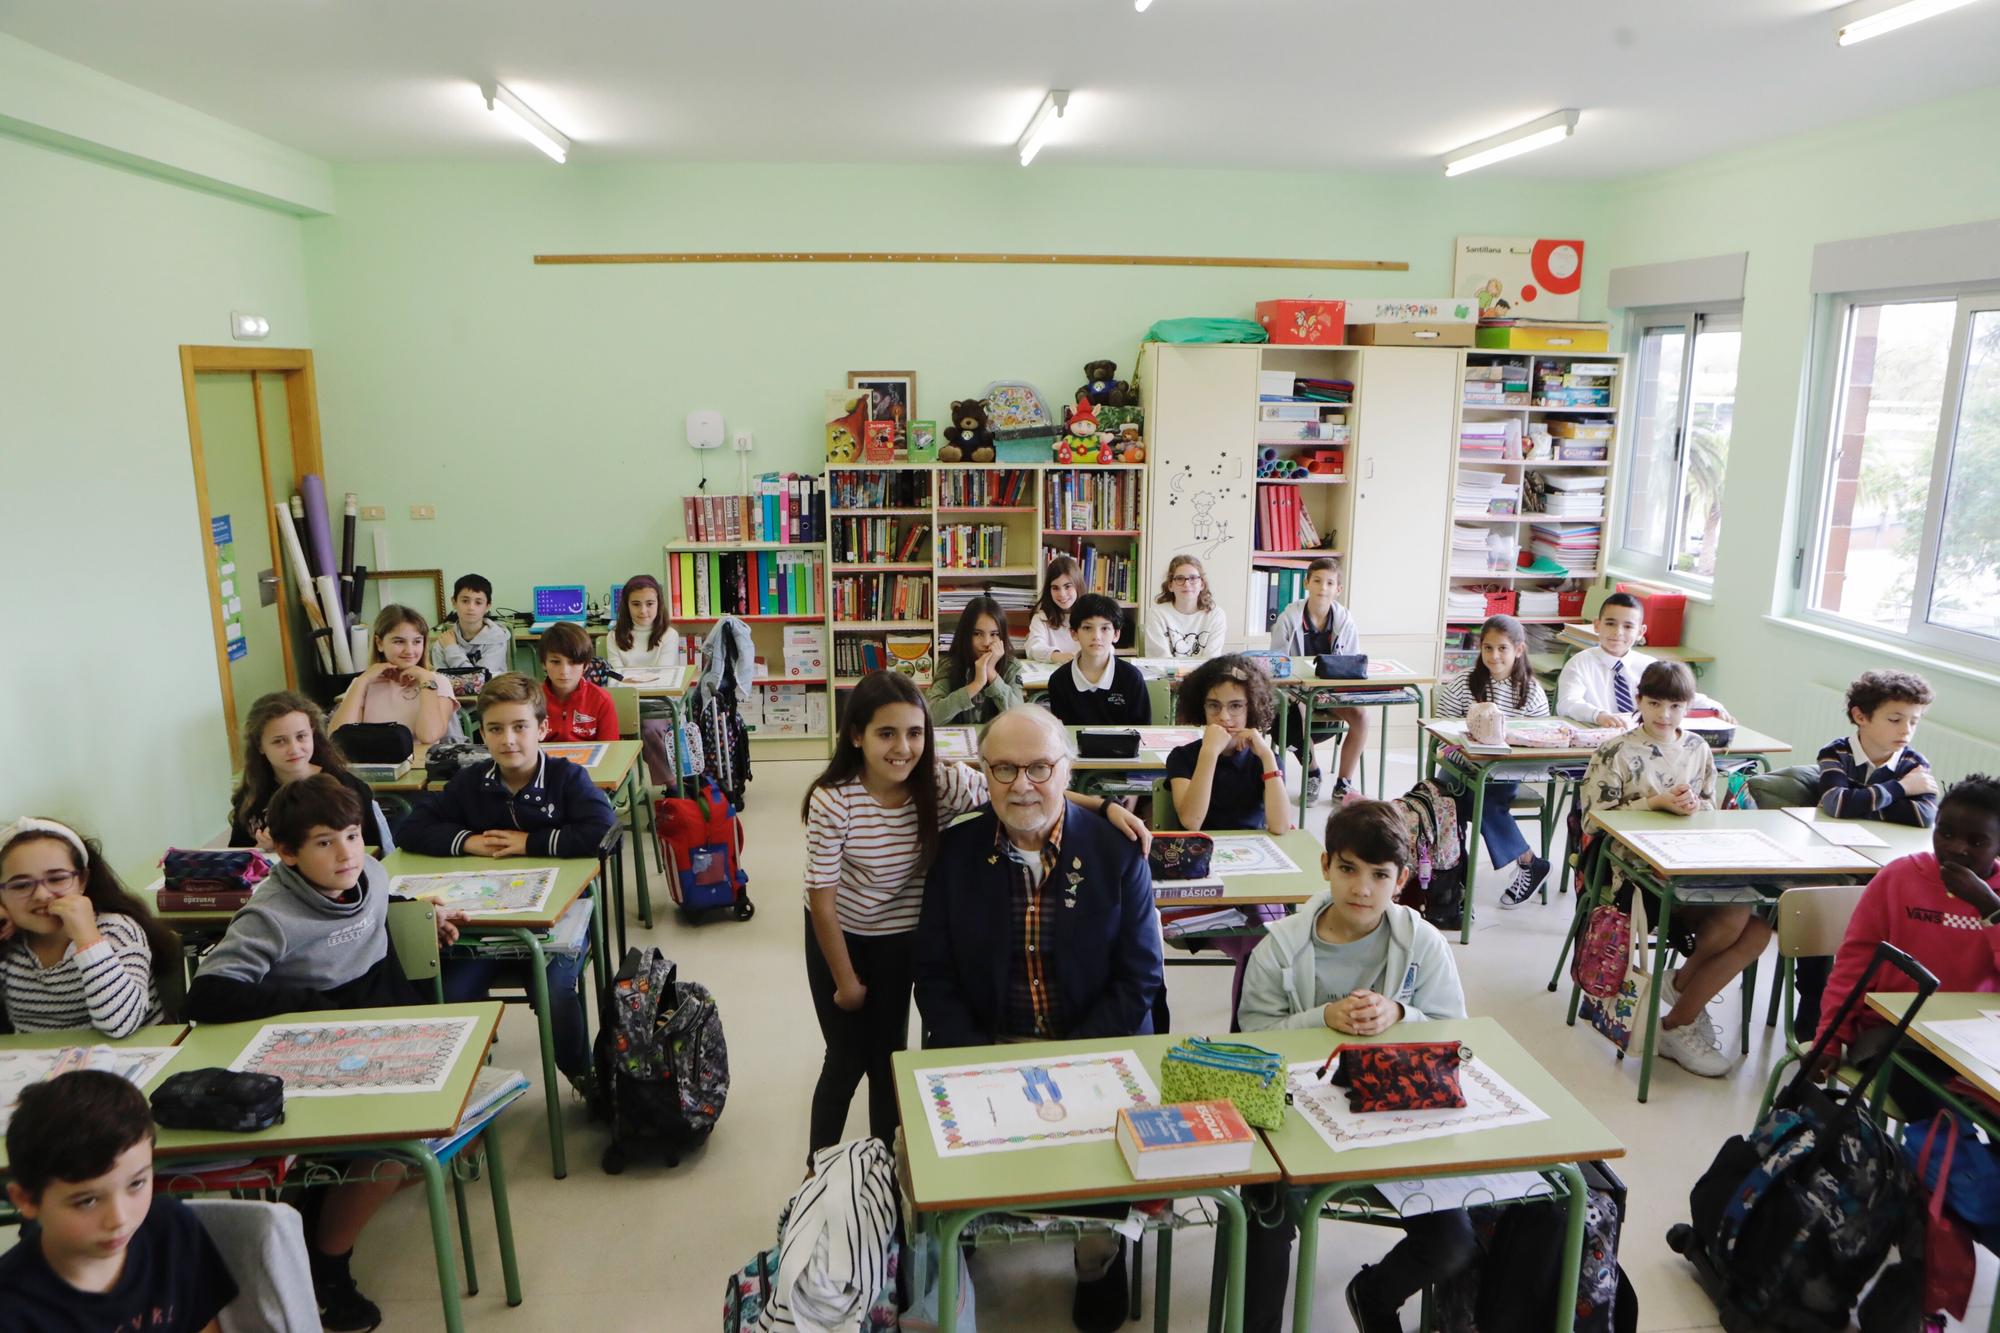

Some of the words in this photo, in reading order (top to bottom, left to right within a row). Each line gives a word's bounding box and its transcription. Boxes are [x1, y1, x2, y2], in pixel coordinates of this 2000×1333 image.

[1466, 246, 1501, 254] Santillana
[1180, 887, 1217, 898] BÁSICO
[183, 896, 216, 904] Avanzado
[1905, 906, 1944, 924] VANS
[1195, 1104, 1225, 1139] ESCOLAR
